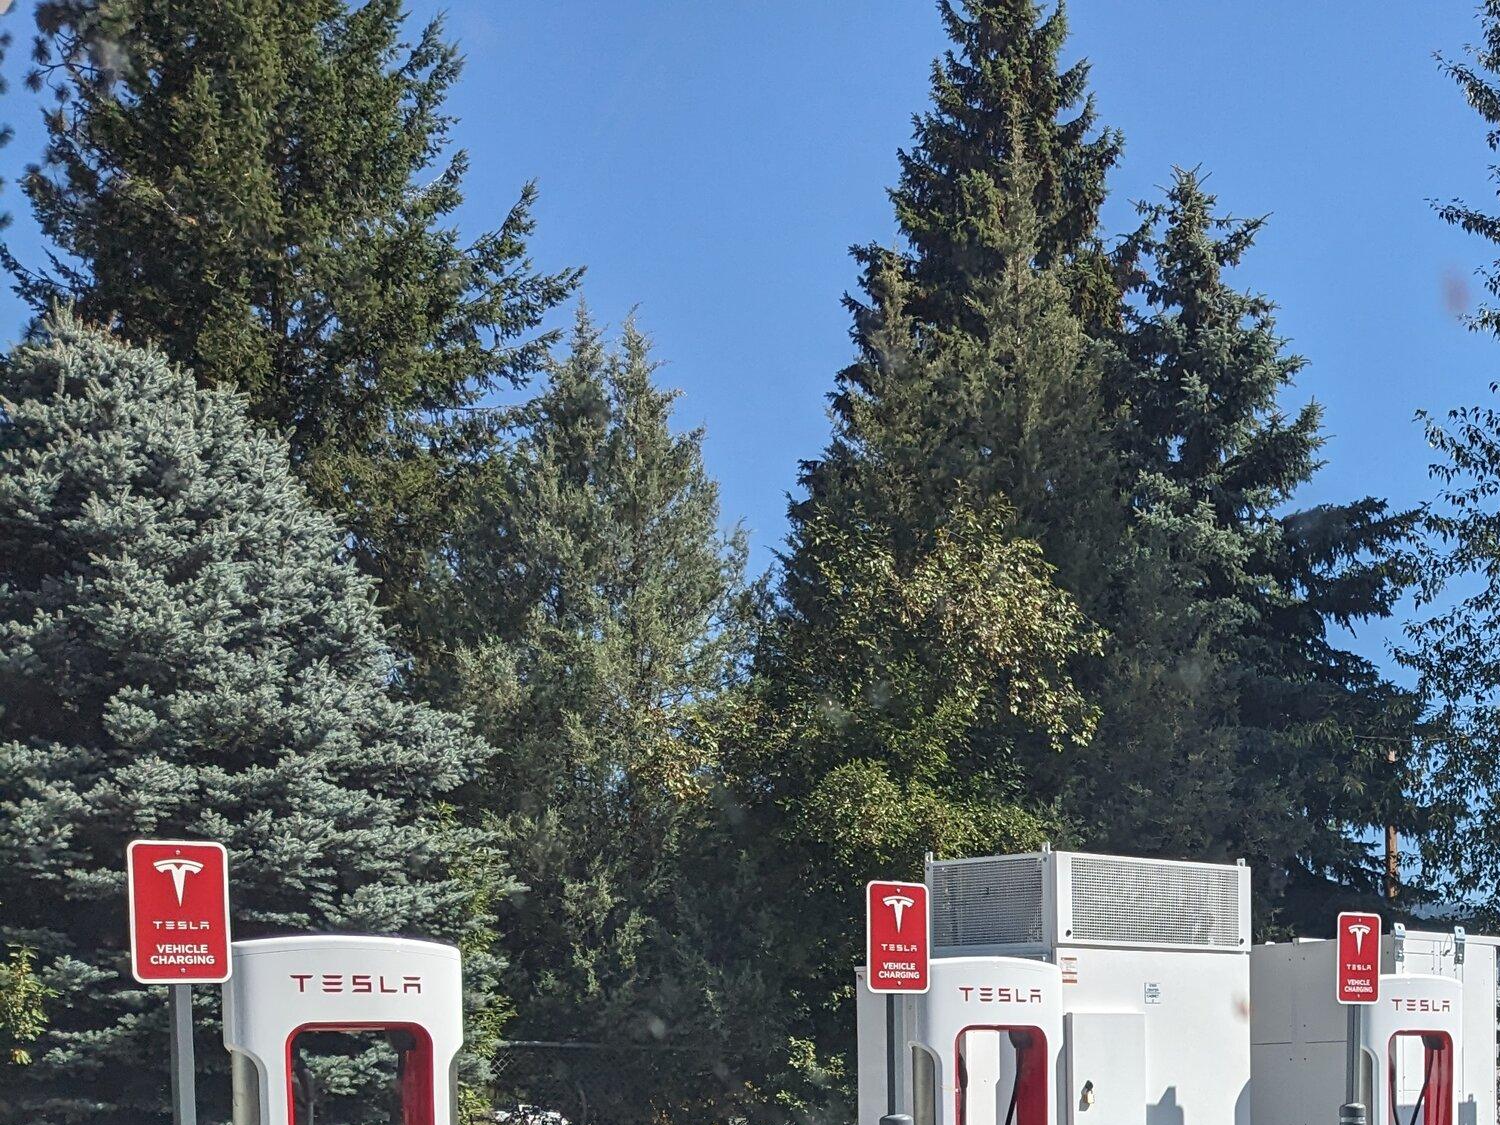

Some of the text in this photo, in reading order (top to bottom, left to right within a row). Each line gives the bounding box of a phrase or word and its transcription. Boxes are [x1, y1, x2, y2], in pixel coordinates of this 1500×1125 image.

[152, 920, 210, 930] TESLA
[156, 944, 208, 954] VEHICLE
[880, 943, 918, 952] TESLA
[150, 955, 215, 965] CHARGING
[882, 962, 916, 970] VEHICLE
[1346, 963, 1372, 971] TESLA
[878, 970, 920, 979] CHARGING
[289, 974, 421, 994] TESLA
[1344, 985, 1373, 993] CHARGING
[958, 987, 1041, 1003] TESLA
[1391, 998, 1450, 1012] TESLA
